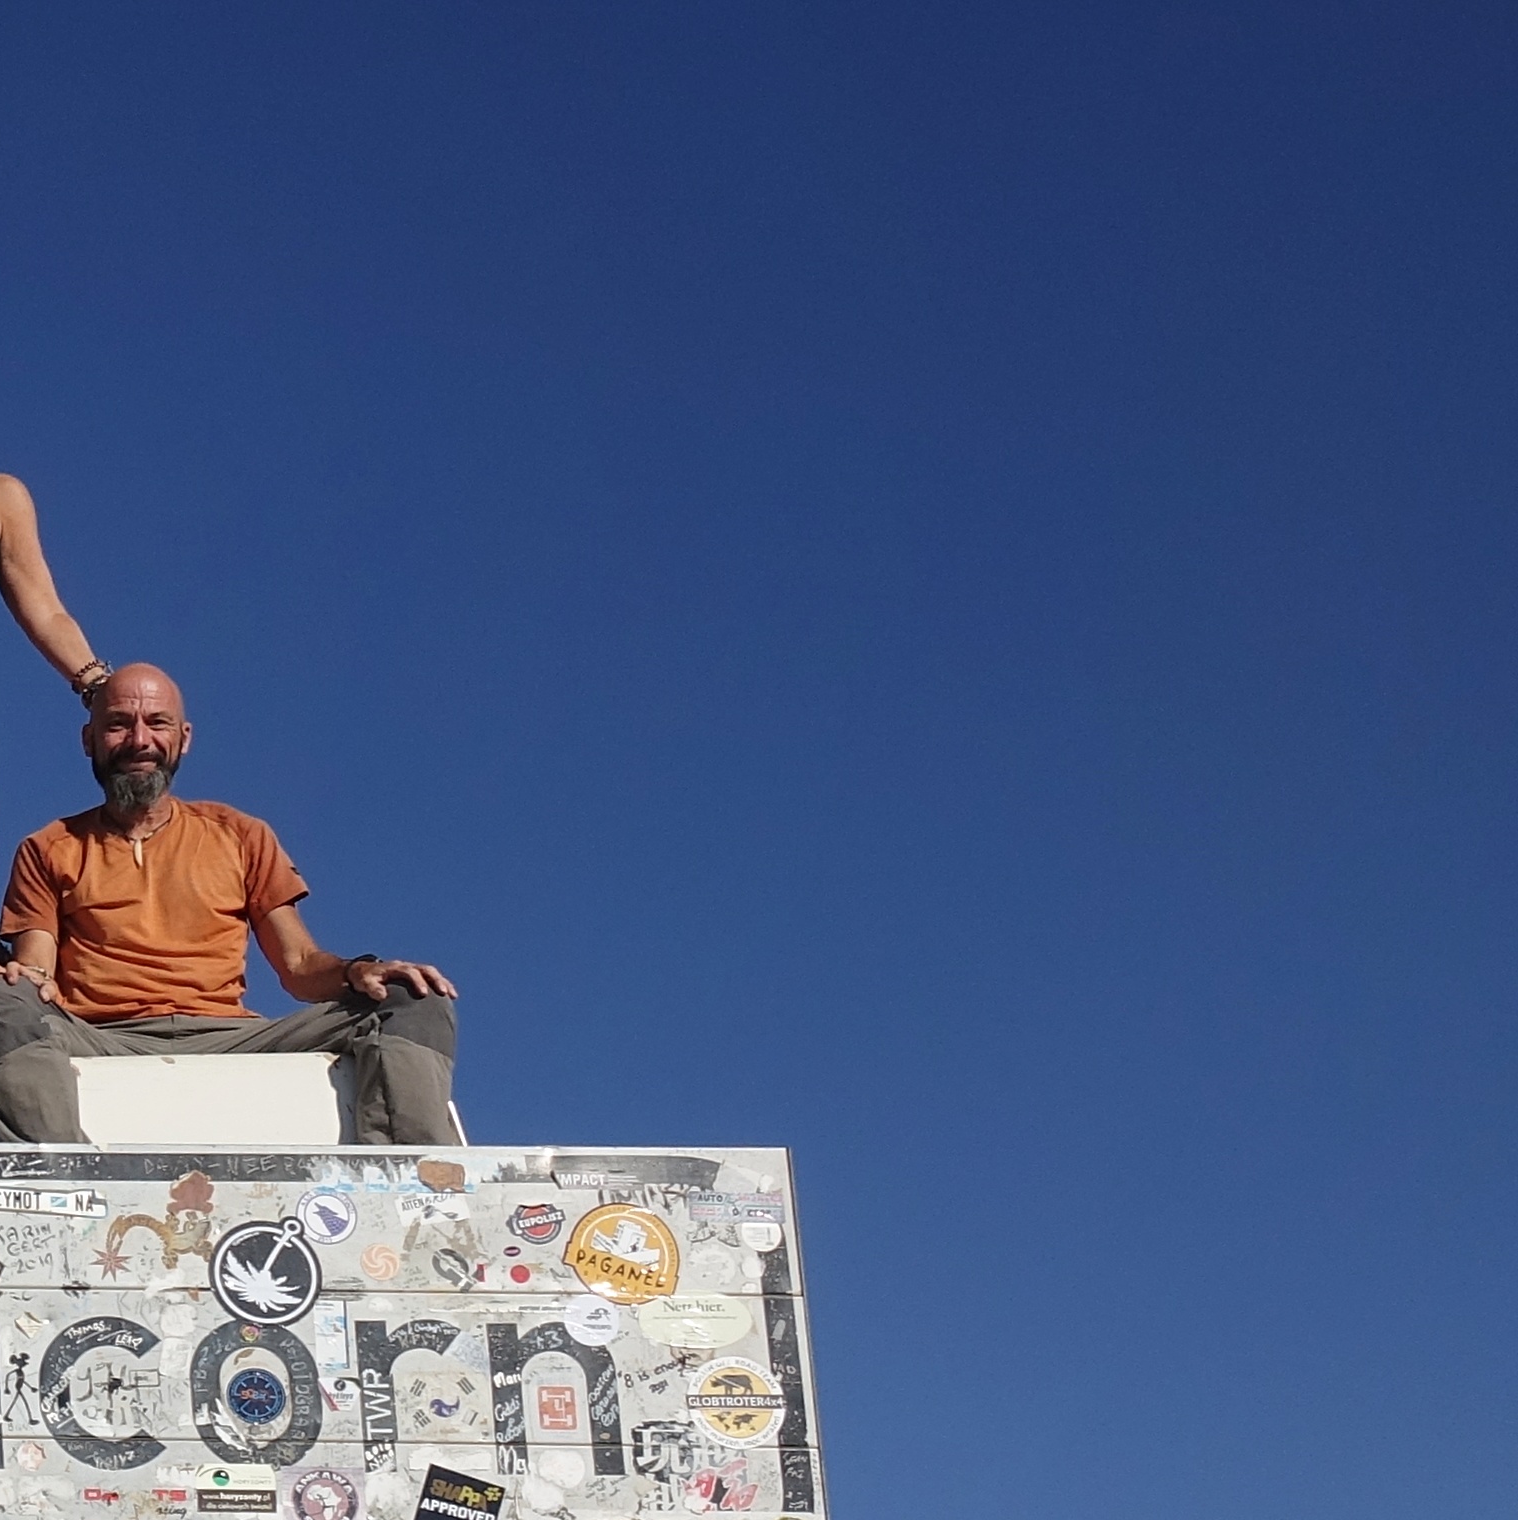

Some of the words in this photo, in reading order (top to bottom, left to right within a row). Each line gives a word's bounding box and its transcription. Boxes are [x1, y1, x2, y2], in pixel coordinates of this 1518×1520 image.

[75, 1194, 94, 1212] NA
[577, 1249, 666, 1289] PAGANEL
[687, 1396, 784, 1407] GLOBTROTER4x4
[295, 1470, 354, 1495] ANKAWA
